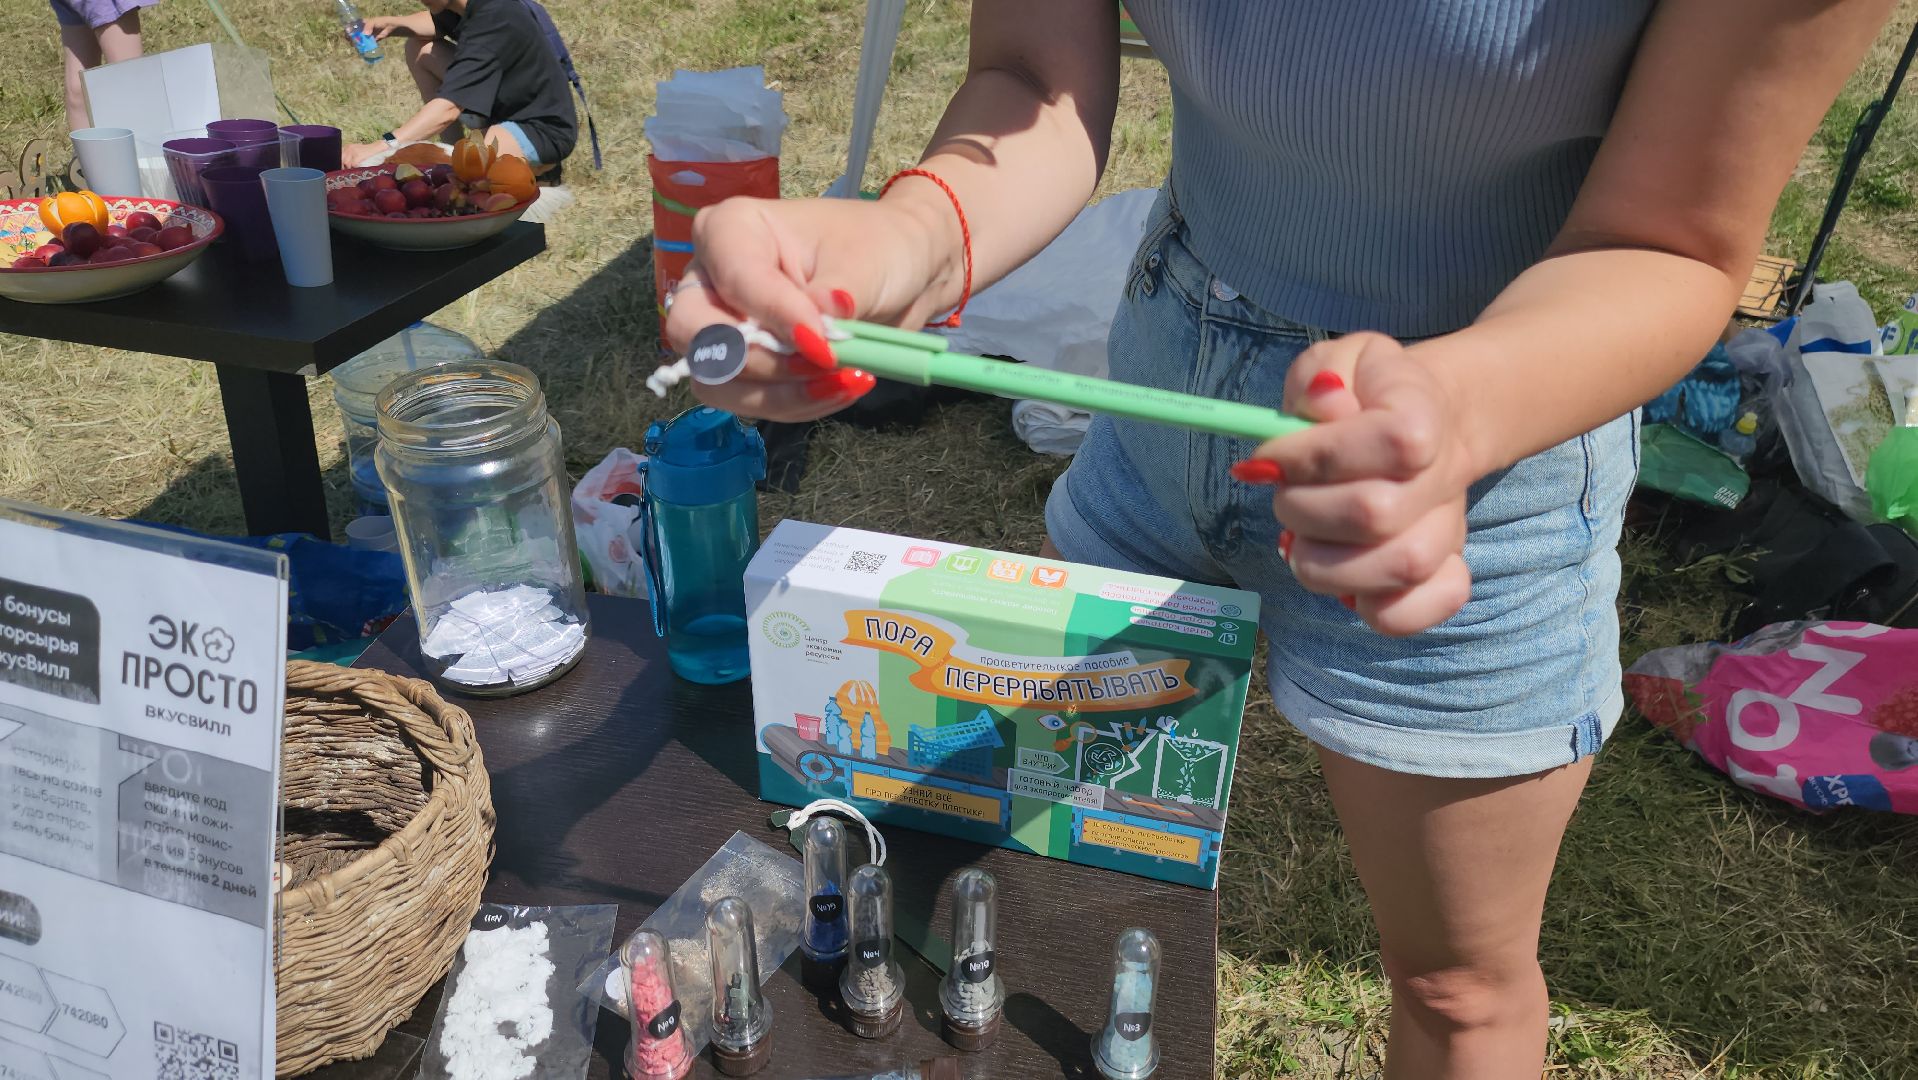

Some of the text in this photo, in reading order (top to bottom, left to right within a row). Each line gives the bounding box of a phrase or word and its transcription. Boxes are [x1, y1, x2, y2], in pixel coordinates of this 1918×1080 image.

[4, 595, 71, 627] бонусы
[865, 617, 934, 657] ПОРА
[980, 654, 1130, 672] просветительское пособие
[122, 650, 258, 715] ПРОСТО
[945, 666, 1180, 702] ПЕРЕРАБАТЫВАТЬ
[145, 704, 232, 737] ВКУСВИЛЛ
[203, 795, 228, 812] код
[201, 816, 234, 833] ожи-
[187, 831, 233, 852] начис-
[188, 847, 244, 876] бонусов
[212, 874, 220, 887] 2
[222, 880, 257, 899] дней
[863, 950, 880, 959] №4
[61, 1002, 109, 1030] 742080
[1123, 1022, 1141, 1033] №3
